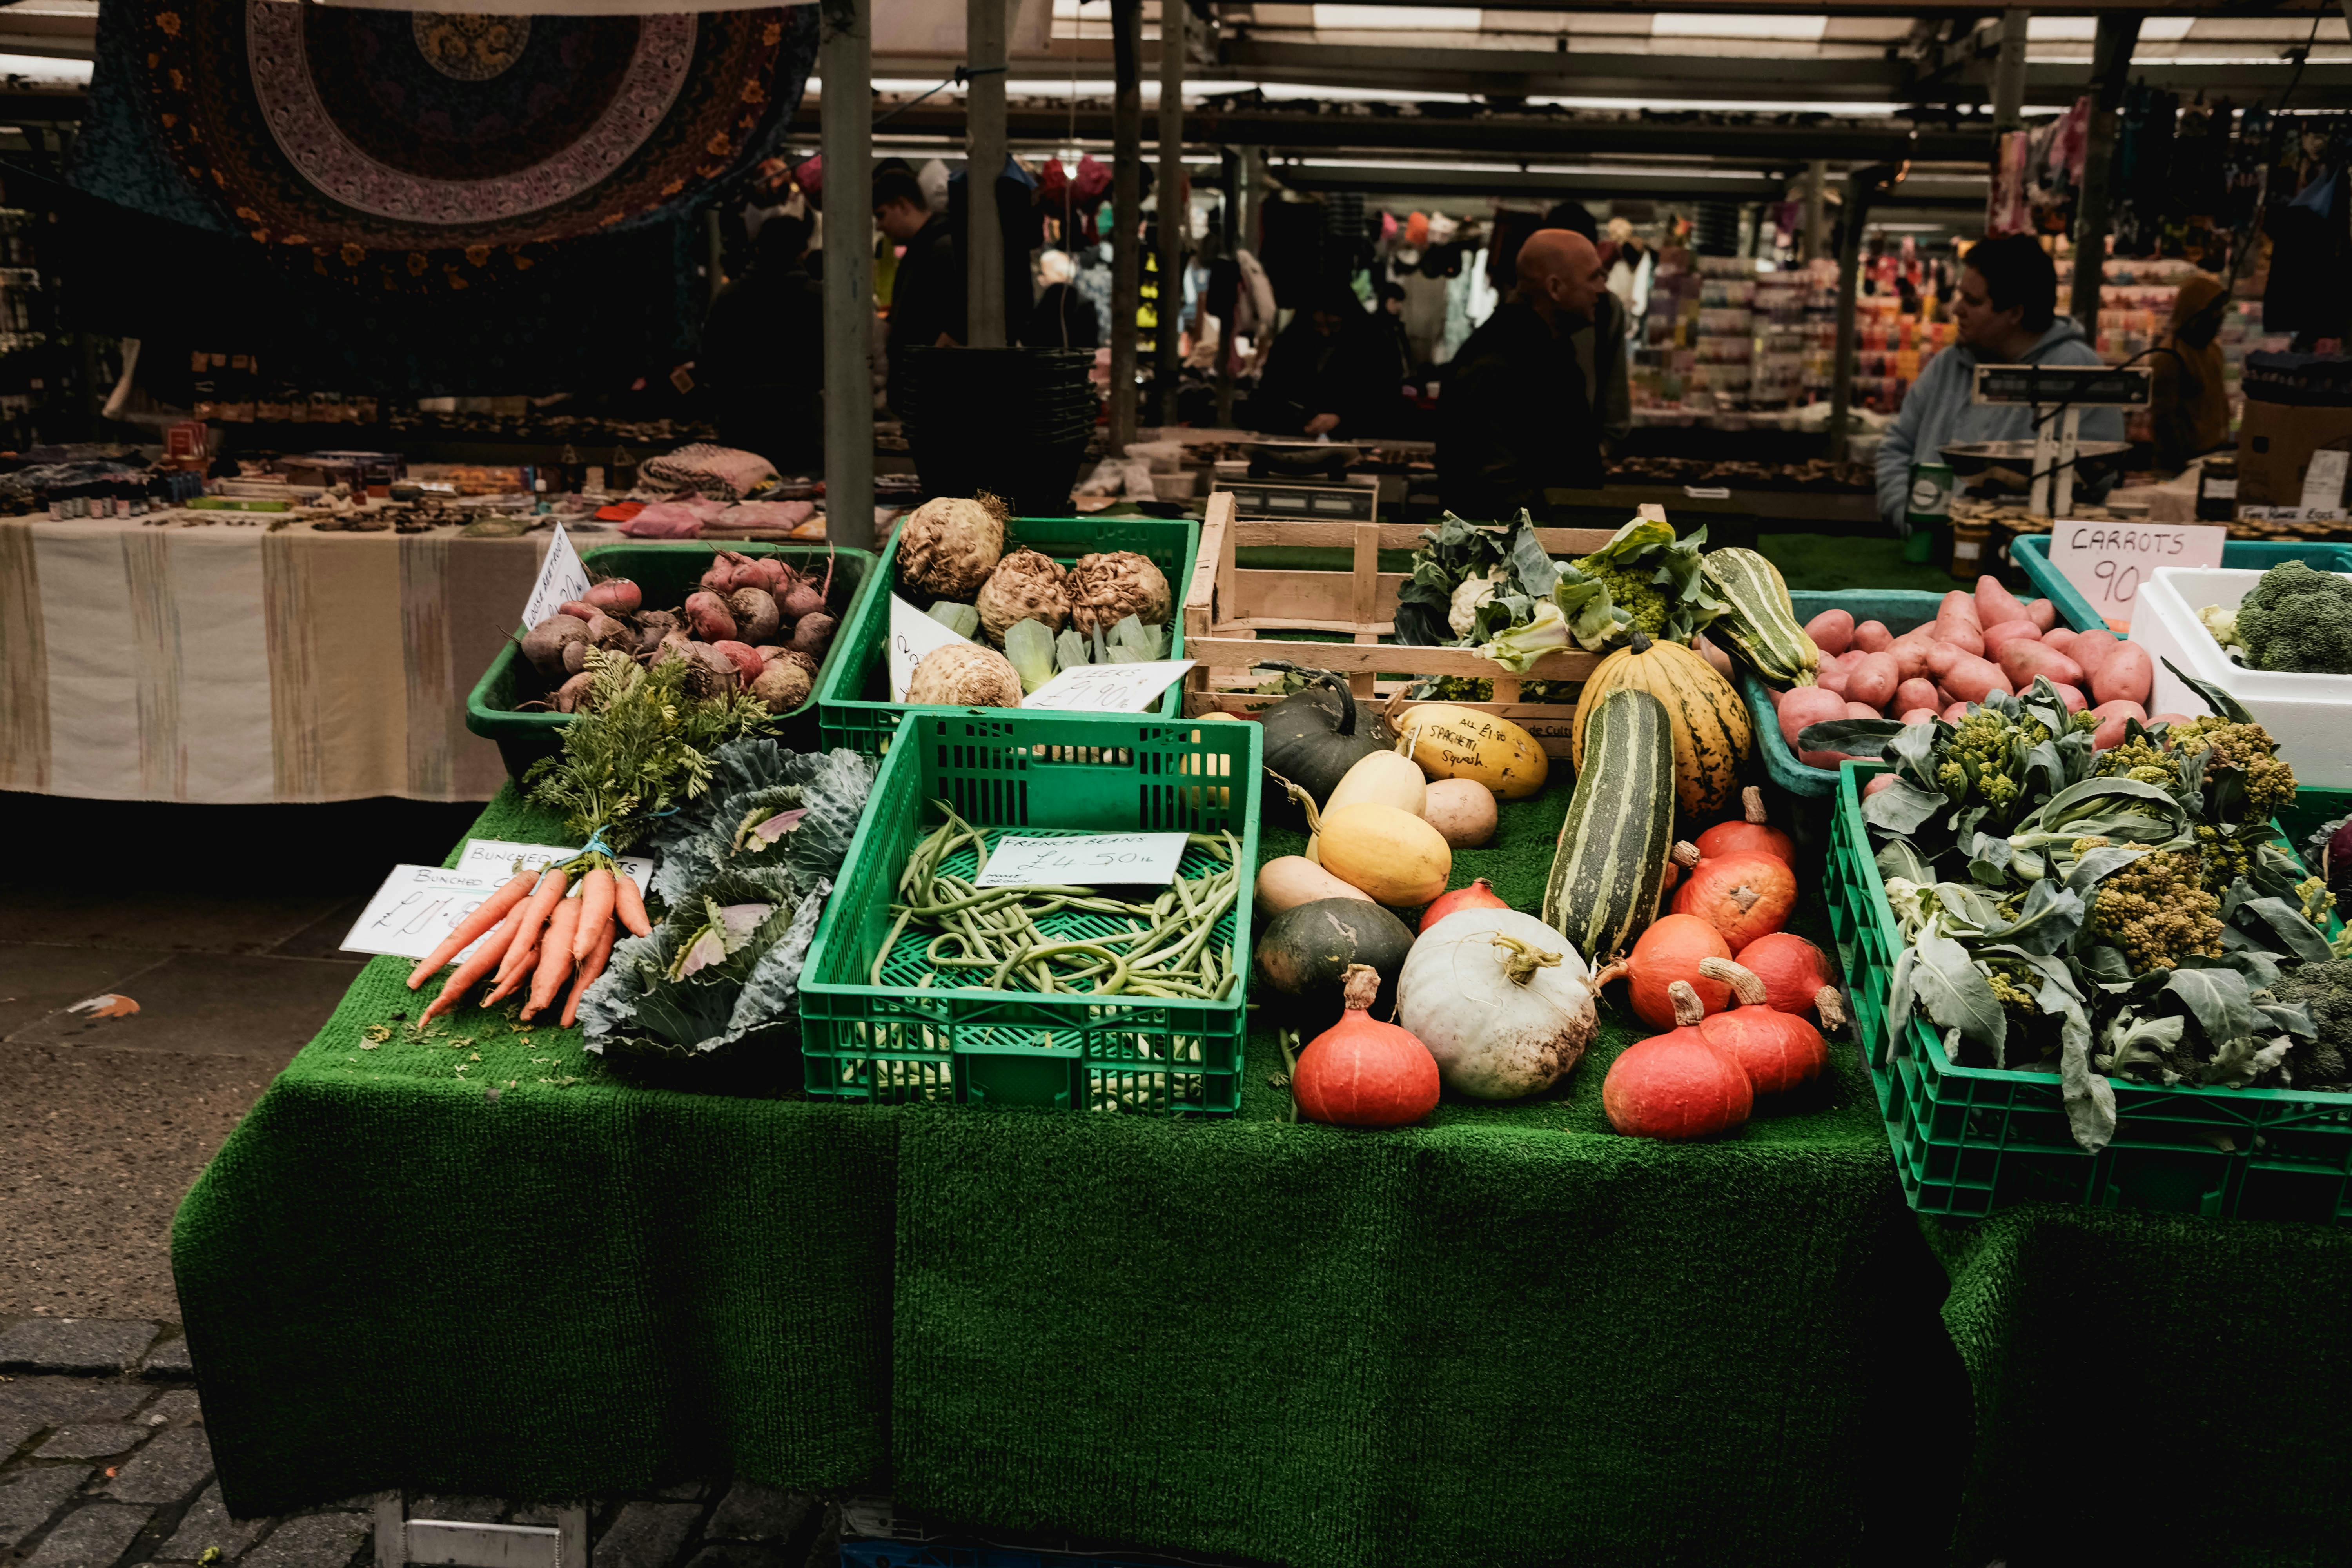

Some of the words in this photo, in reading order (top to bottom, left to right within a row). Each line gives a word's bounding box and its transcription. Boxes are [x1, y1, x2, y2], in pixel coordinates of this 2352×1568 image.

[2072, 529, 2185, 554] CARROTS
[2094, 560, 2140, 603] 90
[1072, 668, 1141, 679] LEEKS
[1529, 725, 1543, 734] de
[1004, 838, 1079, 847] FRENCH
[1084, 837, 1148, 846] BEANS
[471, 847, 552, 863] BUNCHED
[1017, 850, 1138, 871] £4.50
